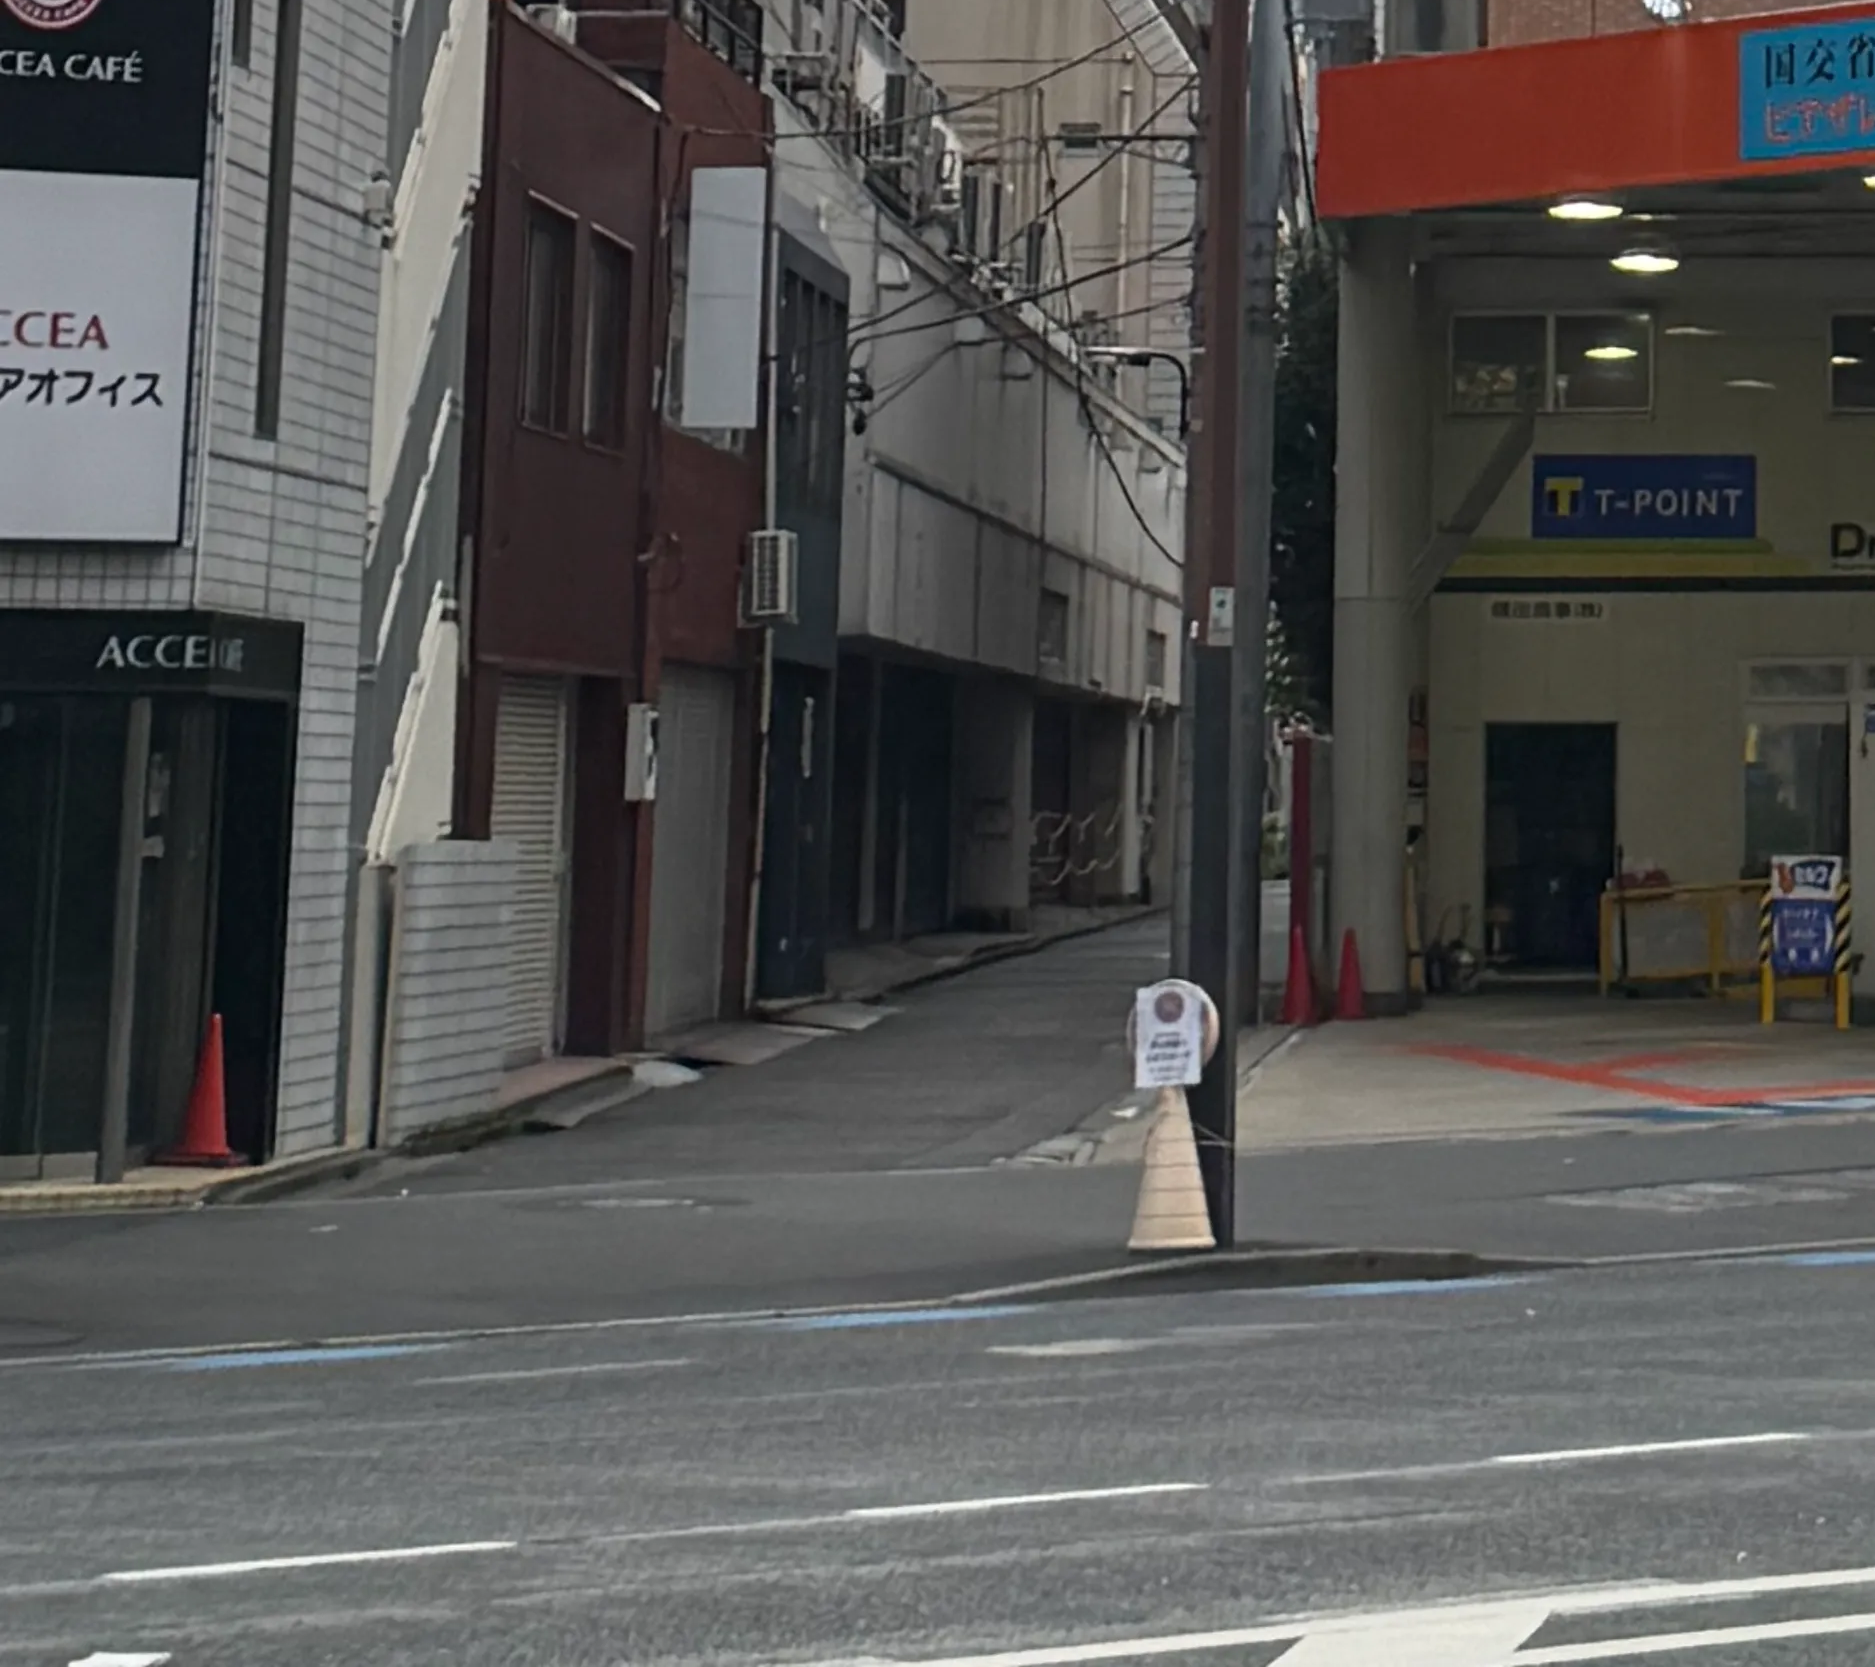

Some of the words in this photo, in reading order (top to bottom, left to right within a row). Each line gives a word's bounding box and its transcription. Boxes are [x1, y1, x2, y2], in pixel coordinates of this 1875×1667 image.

[63, 50, 143, 83] CAFÉ
[0, 366, 164, 408] アオフィス
[1593, 488, 1744, 518] T-POINT
